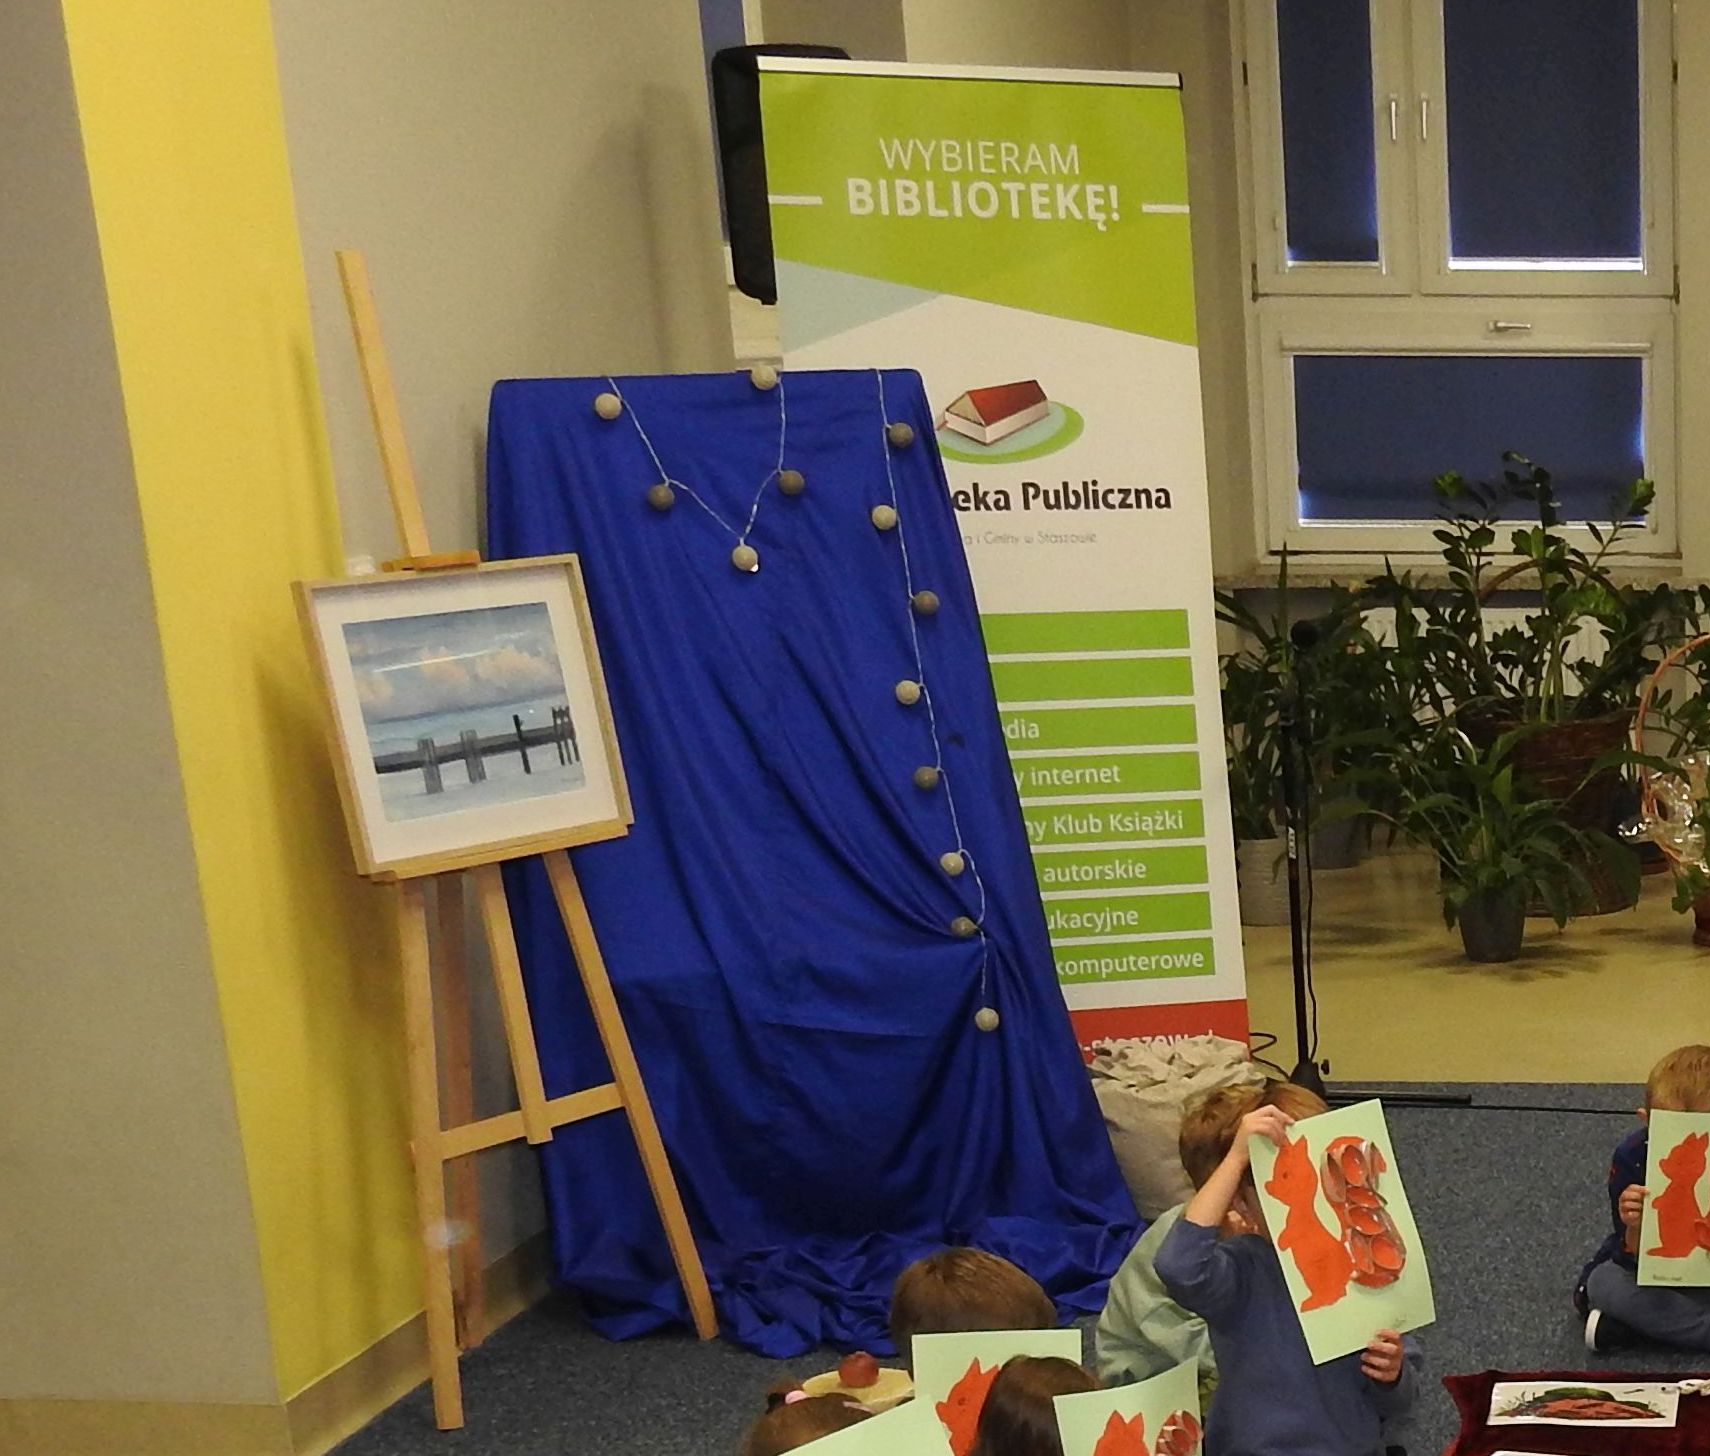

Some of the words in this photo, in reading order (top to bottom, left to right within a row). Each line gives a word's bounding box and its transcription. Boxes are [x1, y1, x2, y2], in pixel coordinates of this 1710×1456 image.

[878, 137, 1080, 176] WYBIERAM
[846, 177, 1121, 231] BIBLIOTEKĘ!
[952, 482, 1012, 512] eka
[1021, 479, 1173, 511] Publiczna
[1003, 718, 1040, 739] dia
[1030, 765, 1121, 786] internet
[1052, 813, 1103, 835] Klub
[1109, 809, 1184, 837] Książki
[1043, 859, 1147, 883] autorskie
